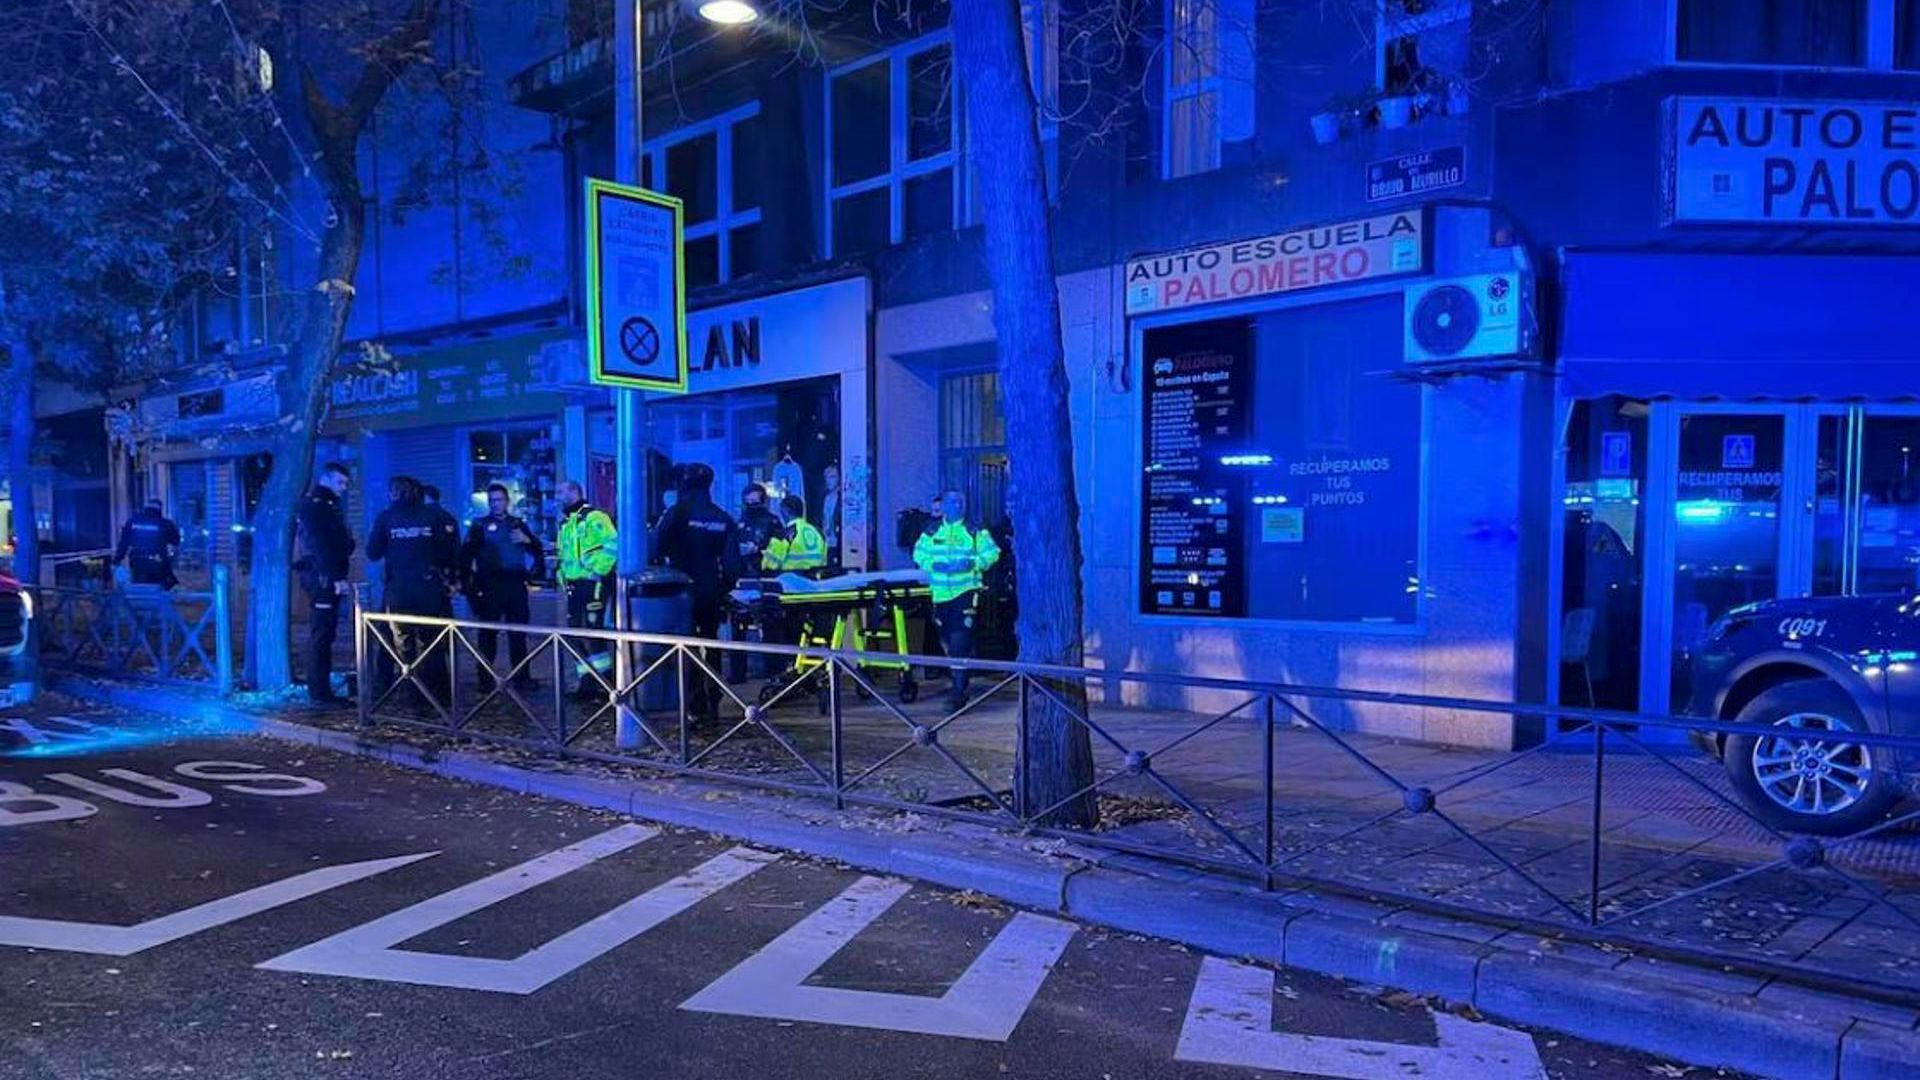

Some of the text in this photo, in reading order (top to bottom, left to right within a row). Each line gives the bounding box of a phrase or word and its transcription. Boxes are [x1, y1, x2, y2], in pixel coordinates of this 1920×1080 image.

[1686, 105, 1863, 149] AUTO
[1763, 157, 1920, 219] PALO
[1129, 250, 1221, 283] AUTO
[1231, 214, 1416, 263] ESCUELA
[1163, 246, 1369, 306] PALOMERO
[1289, 458, 1390, 476] RECUPERAMOS
[1326, 476, 1352, 490] TUS
[1679, 471, 1782, 486] RECUPERAMOS
[1311, 491, 1365, 505] PUNTOS
[1778, 617, 1827, 637] C091
